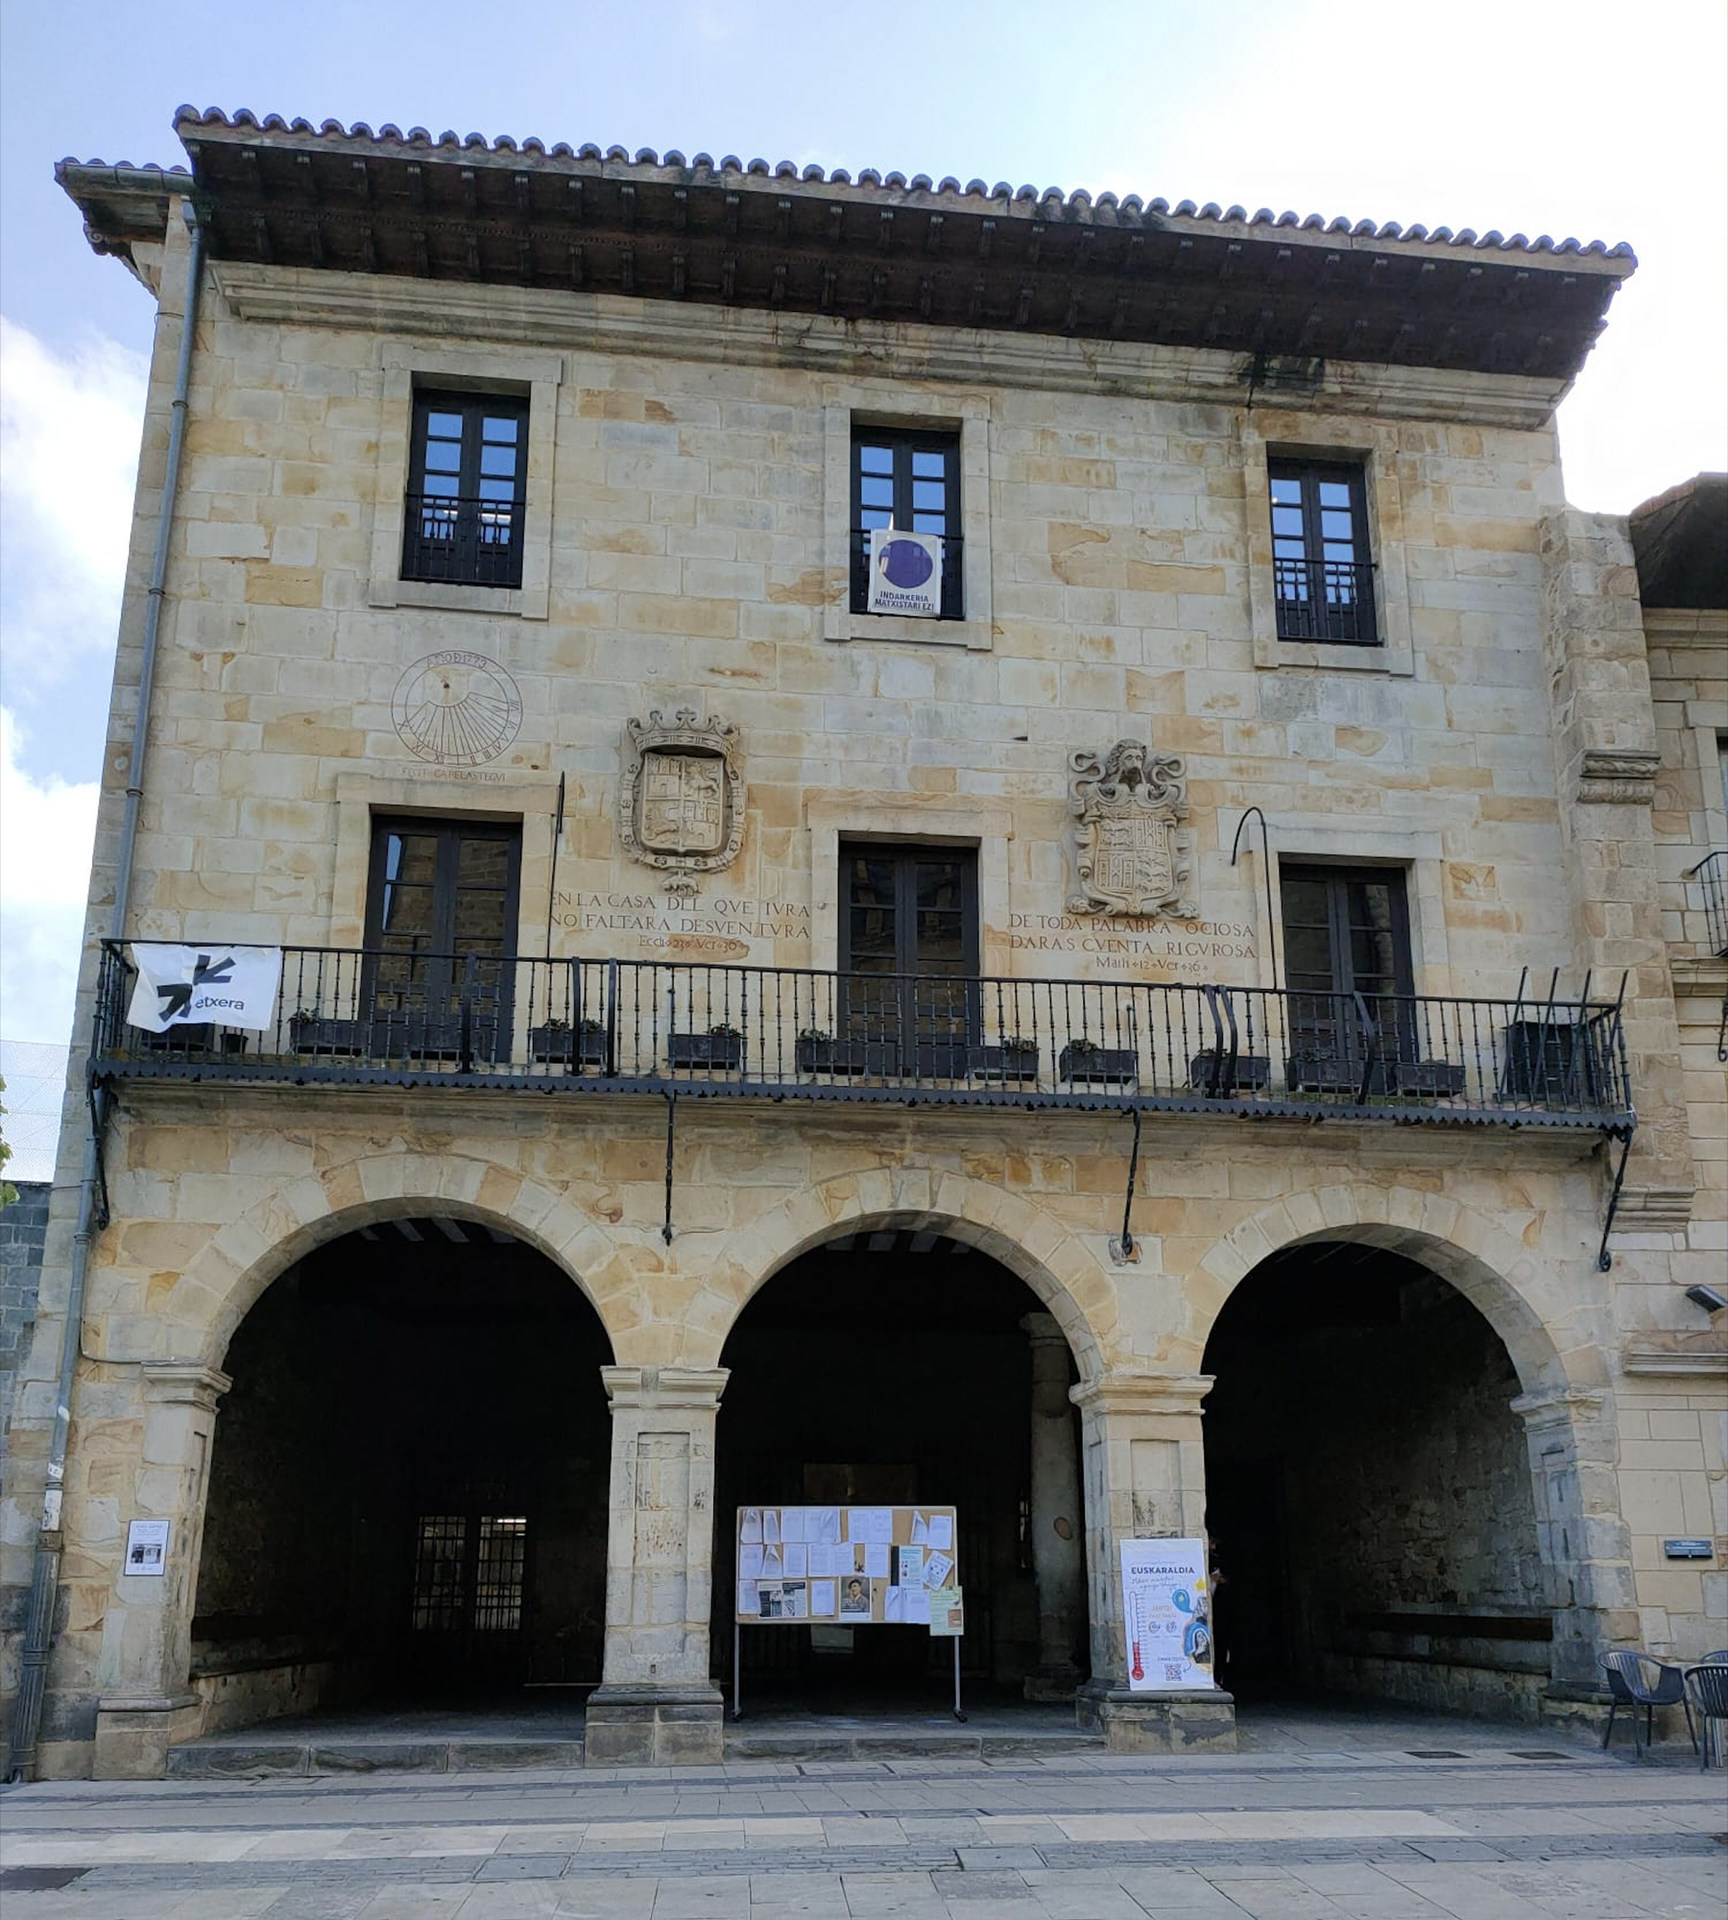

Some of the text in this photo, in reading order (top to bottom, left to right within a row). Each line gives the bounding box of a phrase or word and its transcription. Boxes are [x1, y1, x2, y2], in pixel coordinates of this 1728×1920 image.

[874, 598, 921, 609] MATXISTARI
[880, 590, 929, 602] INDARKERIA
[577, 893, 601, 907] LA
[607, 894, 657, 909] CASA
[714, 899, 755, 917] QVE
[766, 902, 810, 918] IVRA
[551, 913, 810, 939] NO FALTARA DESVENTVRA
[1010, 914, 1254, 937] DE TODA PALABRA OCIOSA
[1010, 934, 1256, 958] DARAS CVENTA RIGVROSA
[195, 995, 245, 1011] etxera
[1131, 1566, 1195, 1575] EUSKARALDIA
